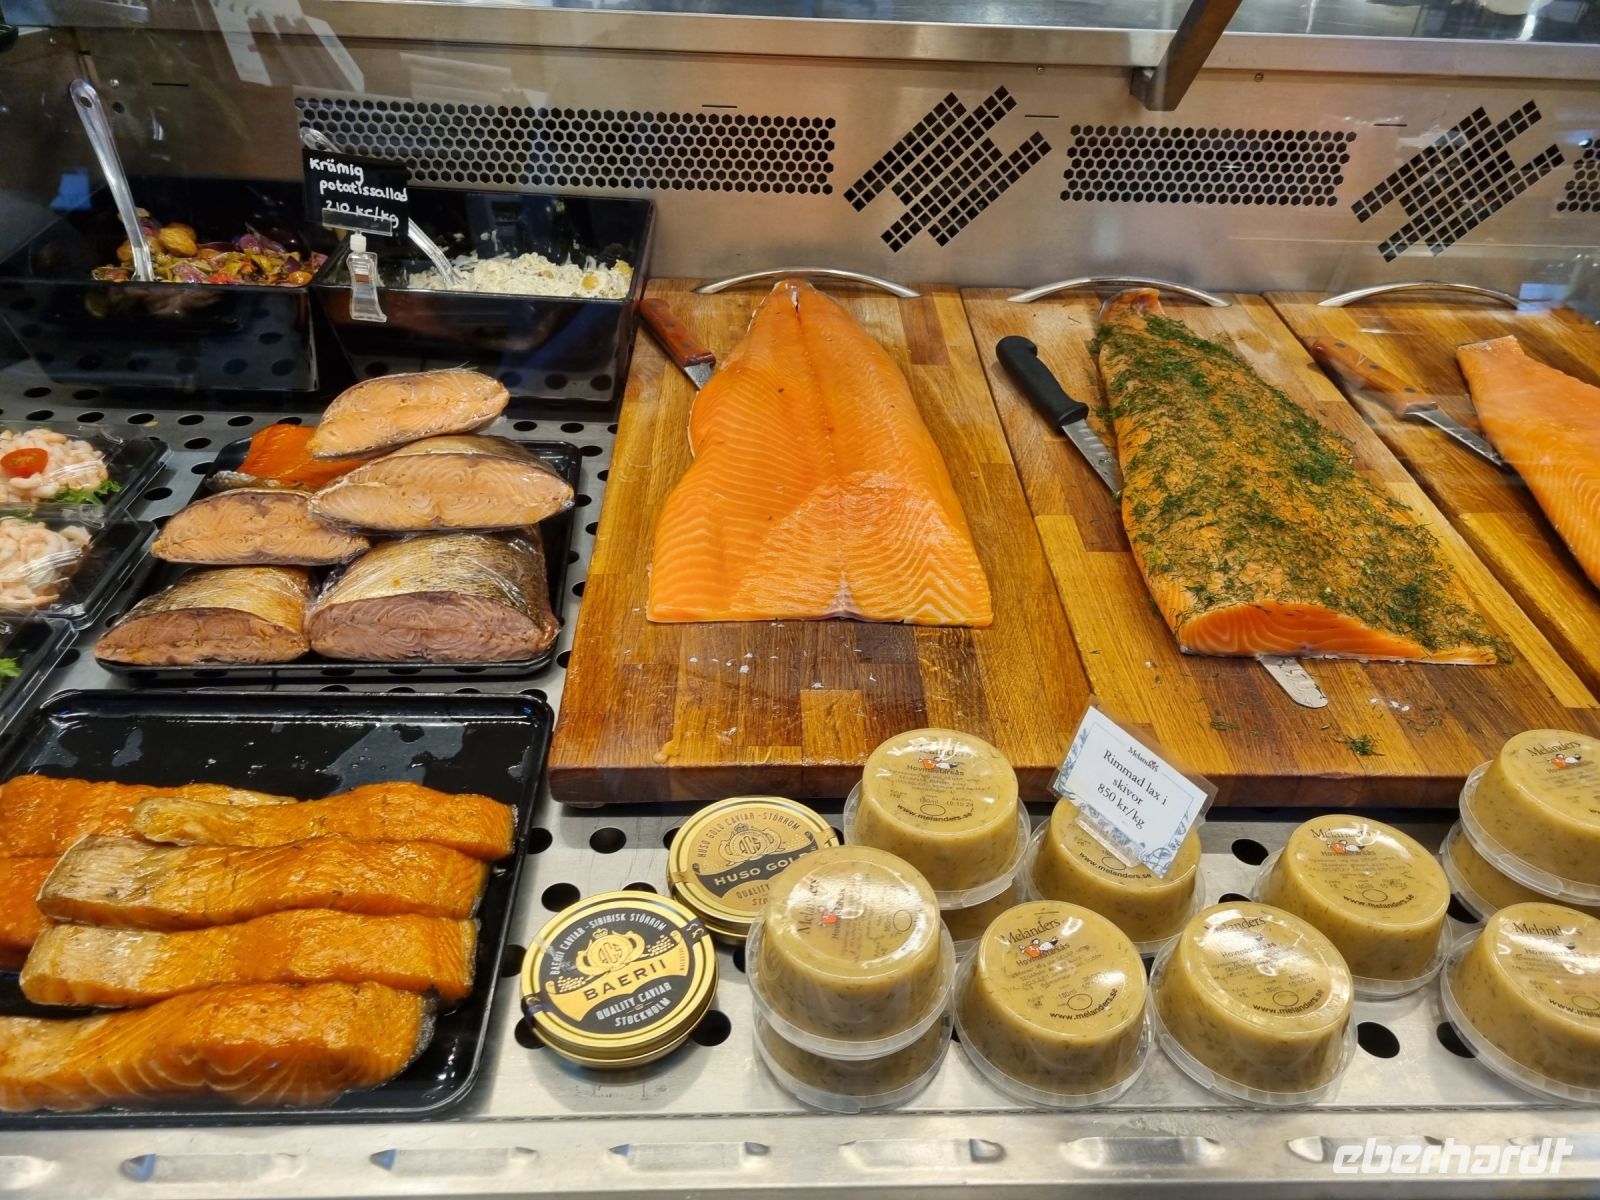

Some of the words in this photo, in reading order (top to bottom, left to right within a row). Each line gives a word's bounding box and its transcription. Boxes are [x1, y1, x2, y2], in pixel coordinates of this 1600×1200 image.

[319, 179, 409, 202] potatissallad
[325, 200, 350, 213] 210
[355, 205, 400, 229] kr/kg
[1103, 749, 1146, 788] Rimmad
[1145, 781, 1163, 801] lax
[1162, 795, 1169, 806] i
[1112, 778, 1144, 805] skivor
[1097, 783, 1117, 803] 850
[1116, 799, 1145, 830] kr/kg
[697, 839, 710, 858] HUSO
[725, 812, 755, 826] CAVIAR
[713, 868, 761, 887] HUSO
[766, 853, 807, 872] GOL
[1079, 852, 1152, 880] www.melanders.se
[735, 883, 771, 900] QUALITY
[560, 926, 586, 951] CAVIAR
[583, 958, 667, 1002] BAERII
[596, 997, 636, 1021] QUALITY
[638, 981, 673, 1003] CAVIAR
[615, 998, 672, 1028] STOCKHOLM
